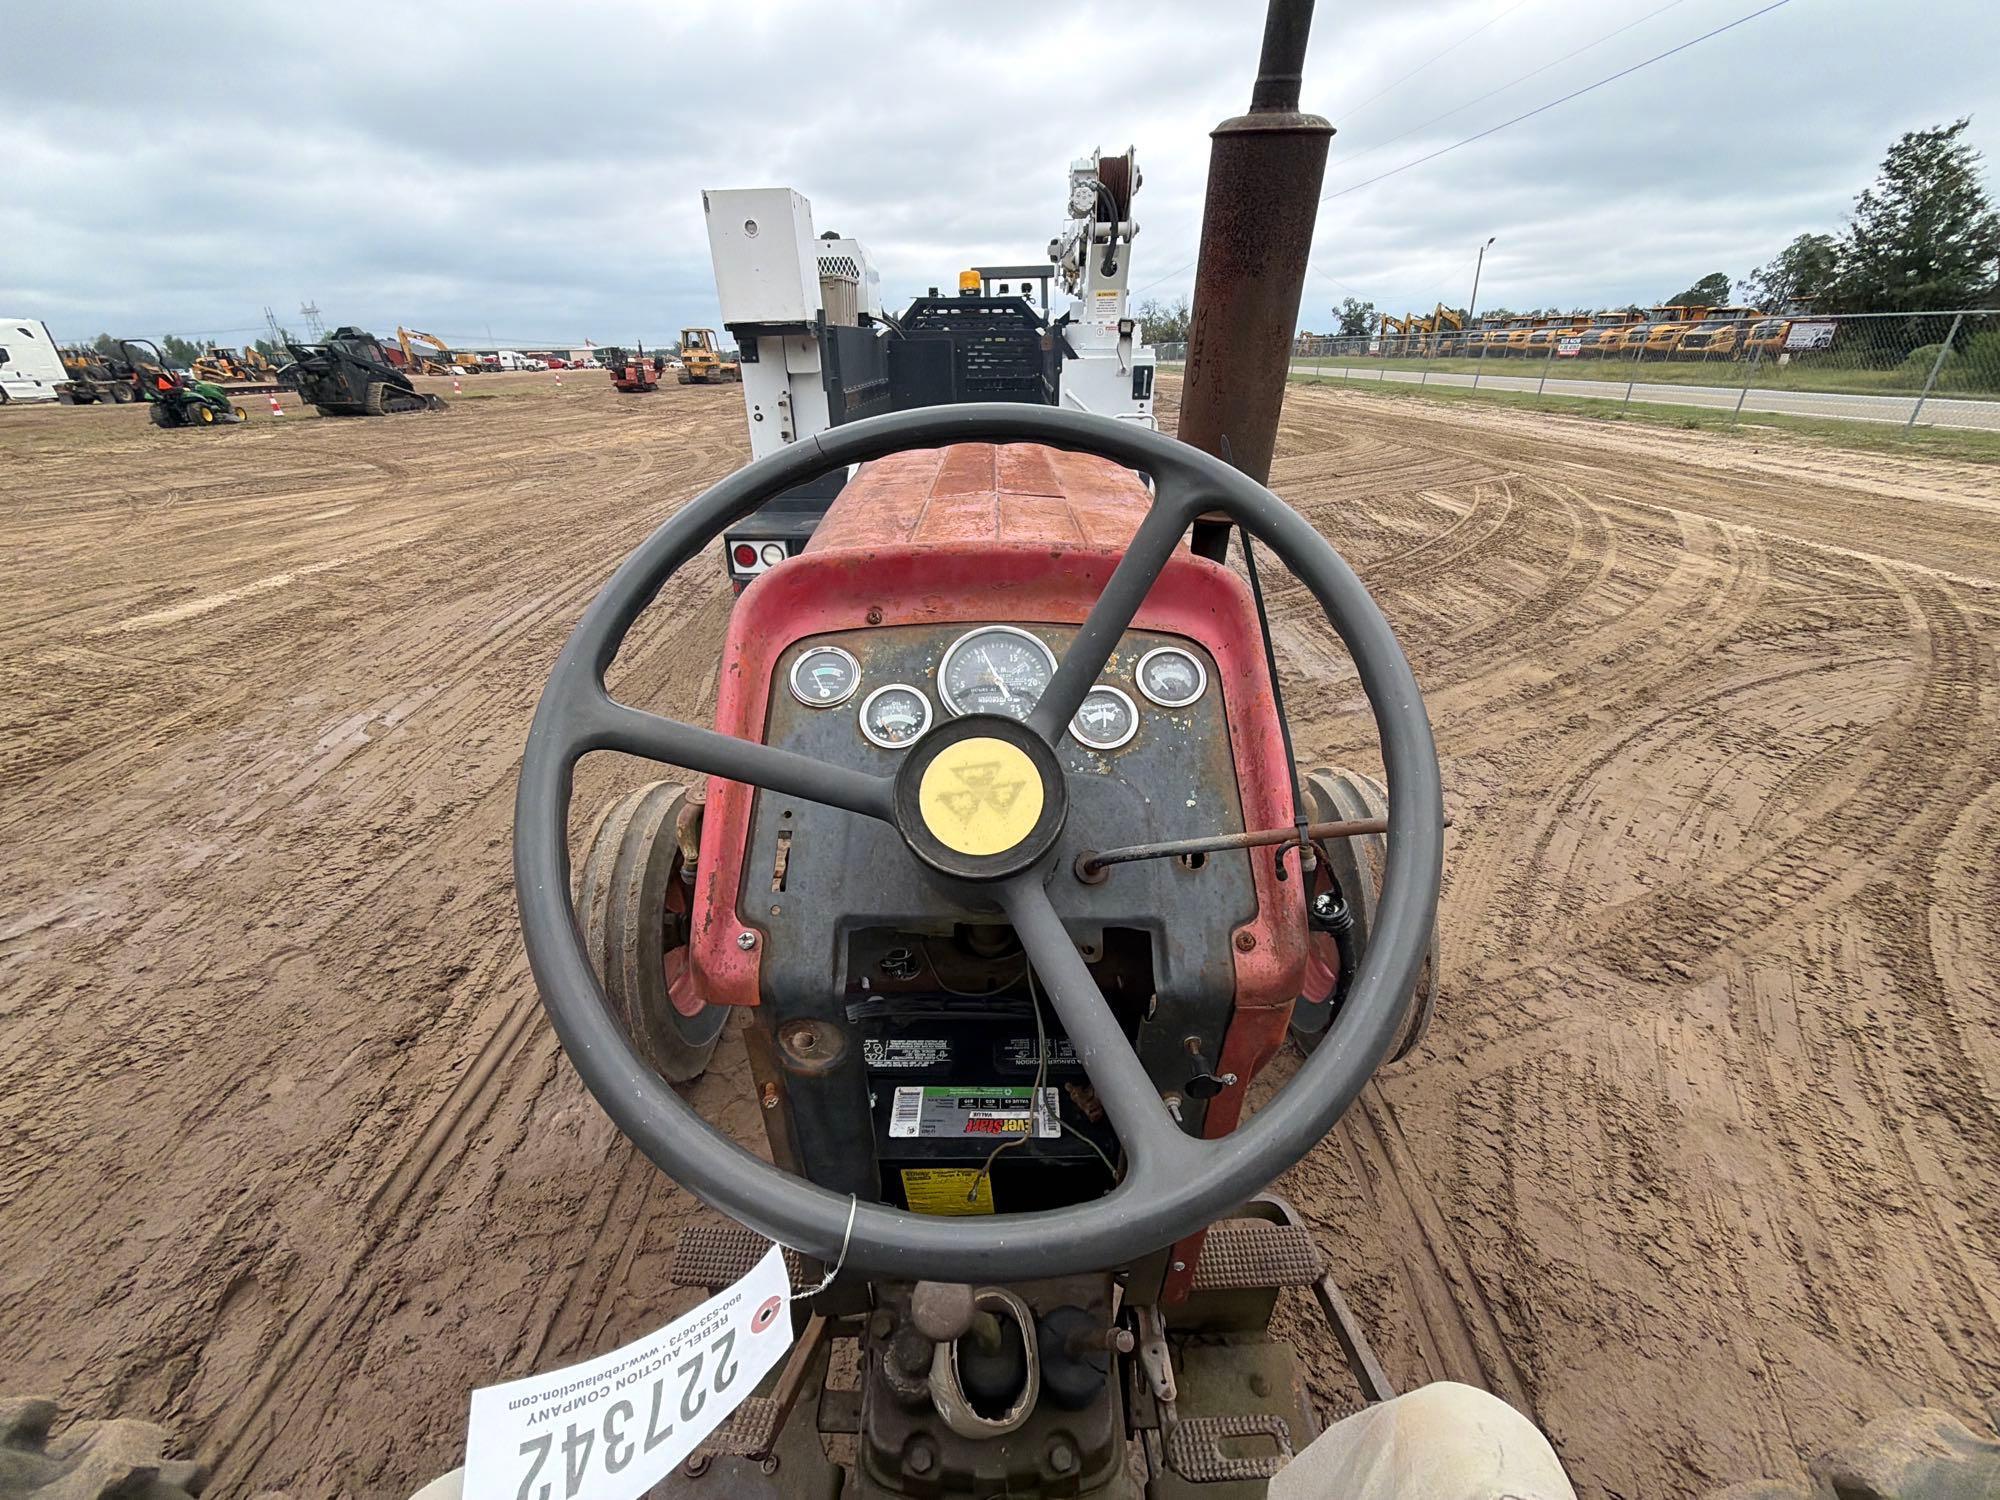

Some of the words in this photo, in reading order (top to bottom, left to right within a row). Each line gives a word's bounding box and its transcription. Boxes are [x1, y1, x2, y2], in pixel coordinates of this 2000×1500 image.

[1010, 654, 1018, 663] 15
[1027, 679, 1038, 687] 20
[669, 1293, 742, 1348] 800-533-0673
[684, 1313, 730, 1349] REBEL
[508, 1347, 660, 1411] www.rebelauction.com
[615, 1346, 683, 1391] AUCTION
[515, 1327, 739, 1500] 227342
[526, 1384, 611, 1427] COMPANY
